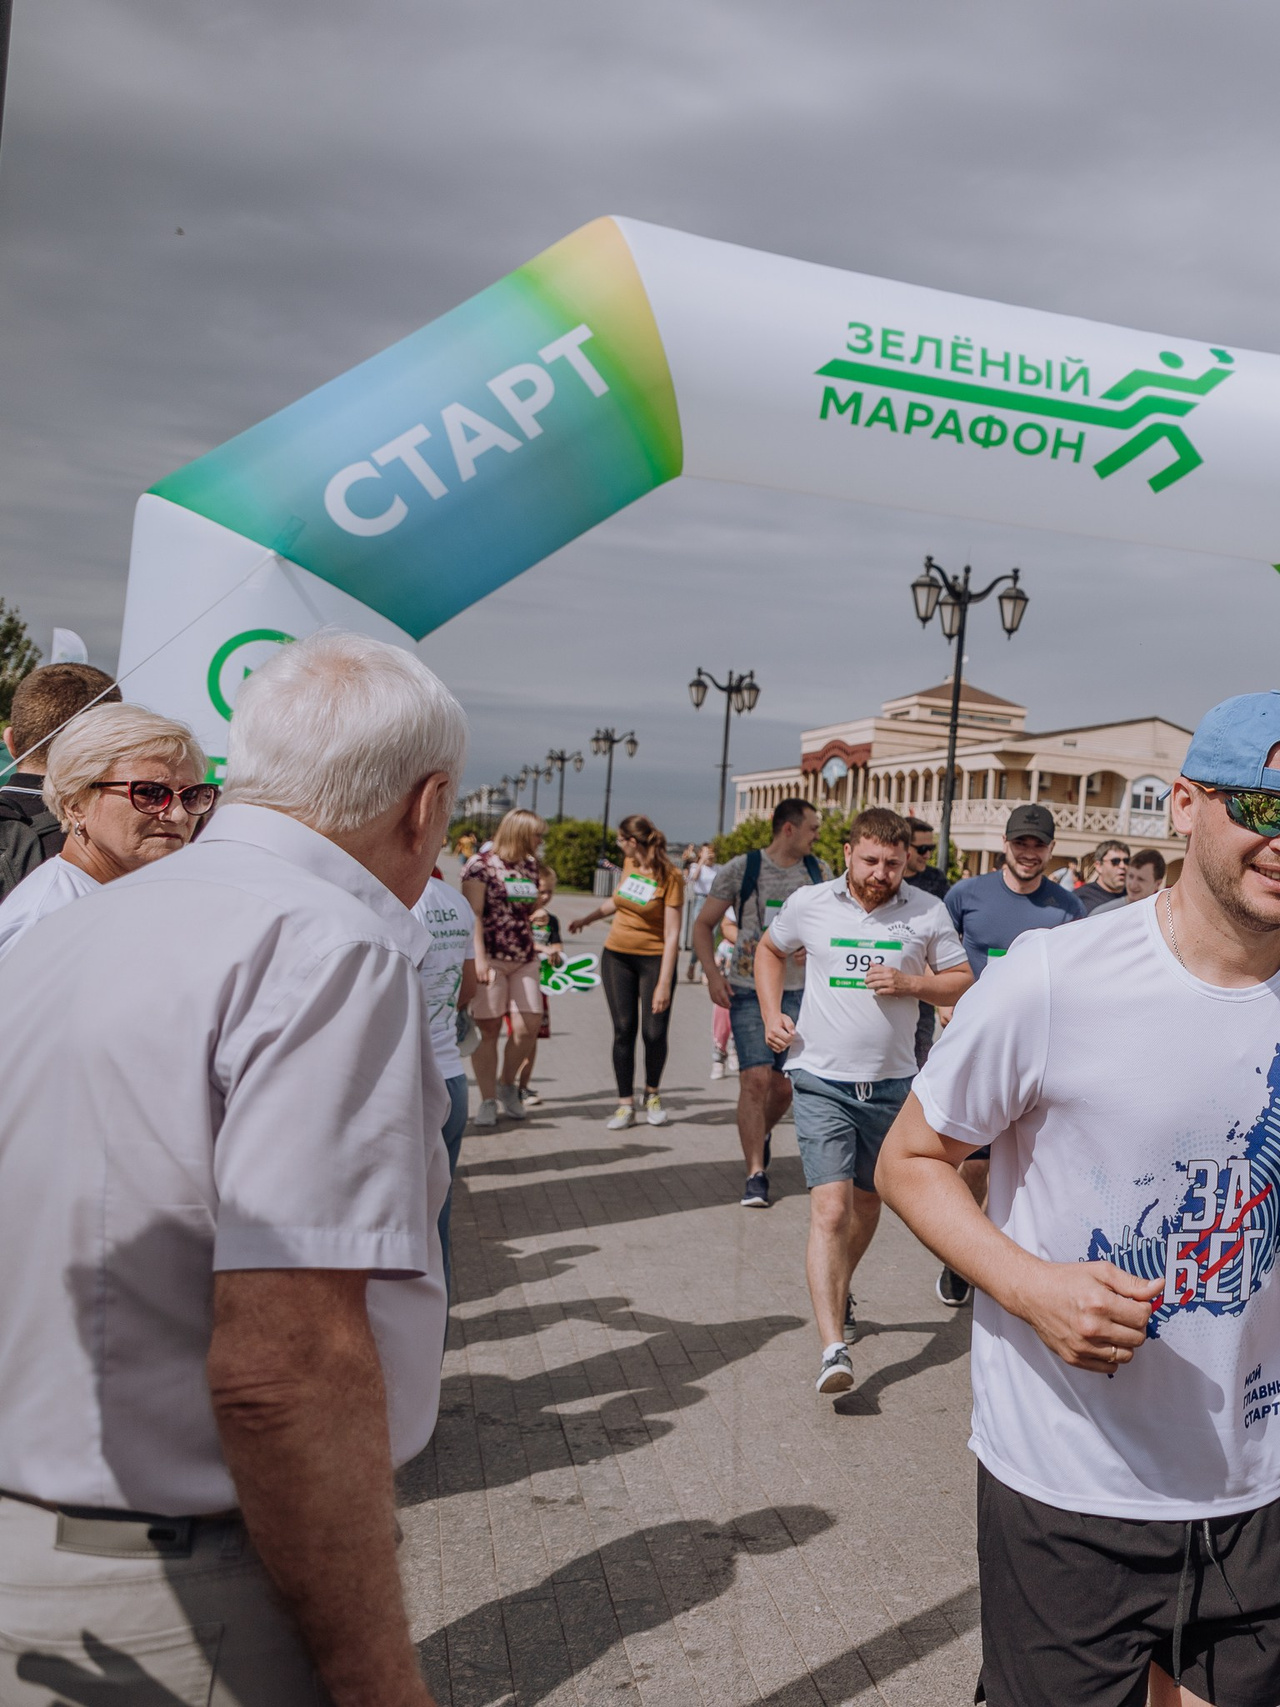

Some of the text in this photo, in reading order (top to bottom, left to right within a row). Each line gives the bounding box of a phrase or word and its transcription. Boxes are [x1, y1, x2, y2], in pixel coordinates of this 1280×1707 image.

[846, 321, 1091, 396] ЗЕЛЁНЫЙ
[324, 323, 610, 537] СТАРТ
[819, 386, 1087, 464] МАРАФОН
[1182, 1158, 1251, 1231] ЗА
[1163, 1228, 1265, 1304] БЕГ
[1244, 1363, 1262, 1390] МОЙ
